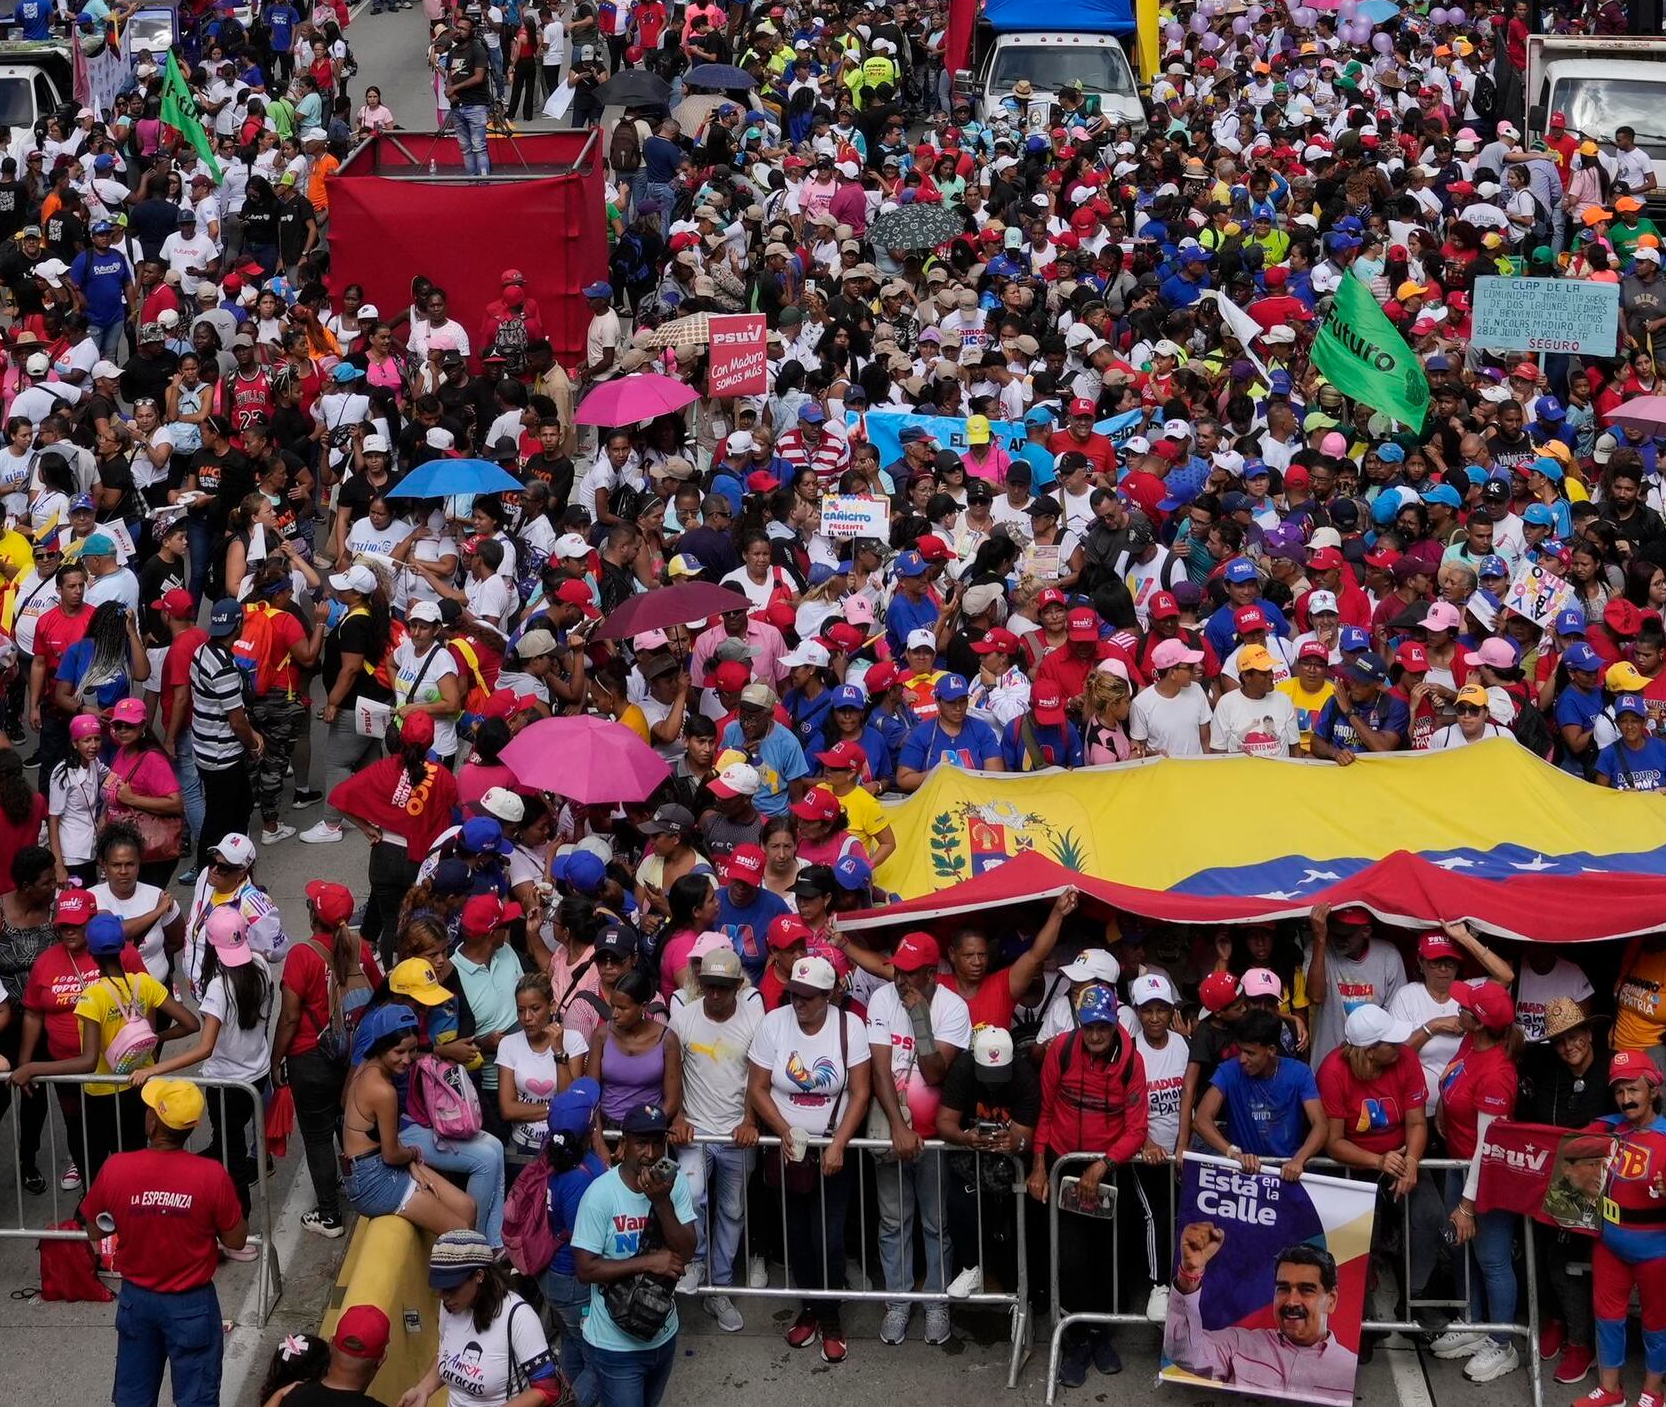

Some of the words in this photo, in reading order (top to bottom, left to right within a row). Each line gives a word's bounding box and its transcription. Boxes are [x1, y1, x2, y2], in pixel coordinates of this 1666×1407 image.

[1469, 213, 1495, 223] Futuro
[1512, 282, 1540, 290] CLAP
[1566, 284, 1580, 292] LA
[1490, 299, 1504, 308] DE
[1506, 300, 1523, 309] DOS
[1499, 328, 1521, 337] JULIO
[1525, 329, 1536, 337] SU
[1540, 330, 1560, 338] VOTO
[1532, 320, 1574, 330] MADURO
[1595, 325, 1605, 334] EL
[1323, 303, 1395, 371] Futuro
[1529, 338, 1580, 351] SEGURO
[711, 364, 728, 379] Con
[730, 351, 764, 372] Maduro
[716, 375, 743, 391] somos
[744, 365, 762, 381] más
[950, 433, 968, 448] EL
[829, 523, 864, 531] PRESENTE
[1198, 1167, 1259, 1192] Está
[1262, 1178, 1280, 1187] en
[131, 1195, 140, 1205] LA
[142, 1191, 193, 1209] ESPERANZA
[1266, 1188, 1280, 1200] la
[1197, 1190, 1276, 1226] Calle
[439, 1360, 485, 1395] Caracas
